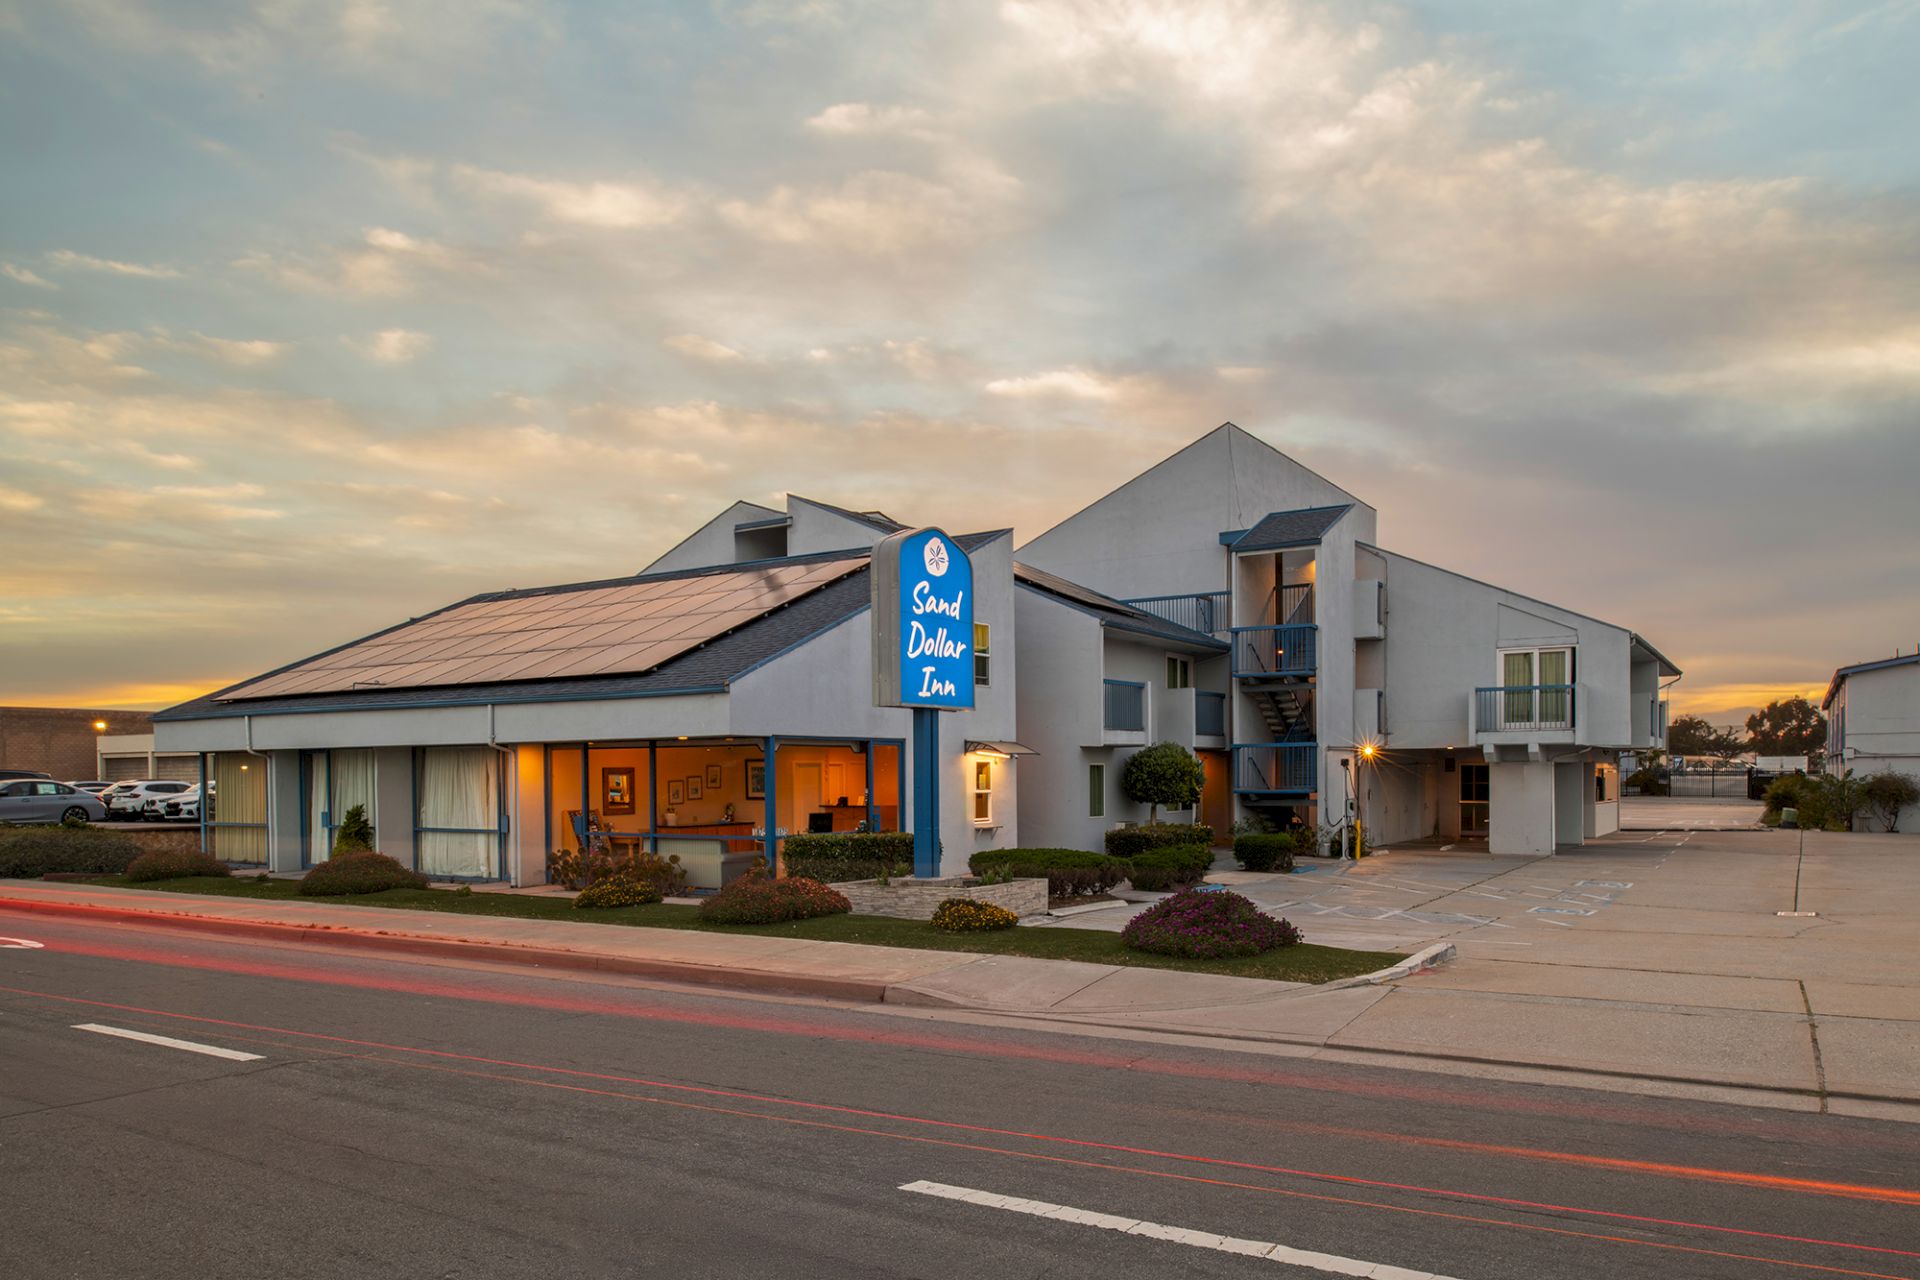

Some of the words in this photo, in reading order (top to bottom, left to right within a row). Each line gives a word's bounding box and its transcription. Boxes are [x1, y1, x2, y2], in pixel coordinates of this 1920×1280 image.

[912, 580, 963, 620] Sand
[907, 620, 967, 659] Dollar
[918, 666, 956, 697] Inn
